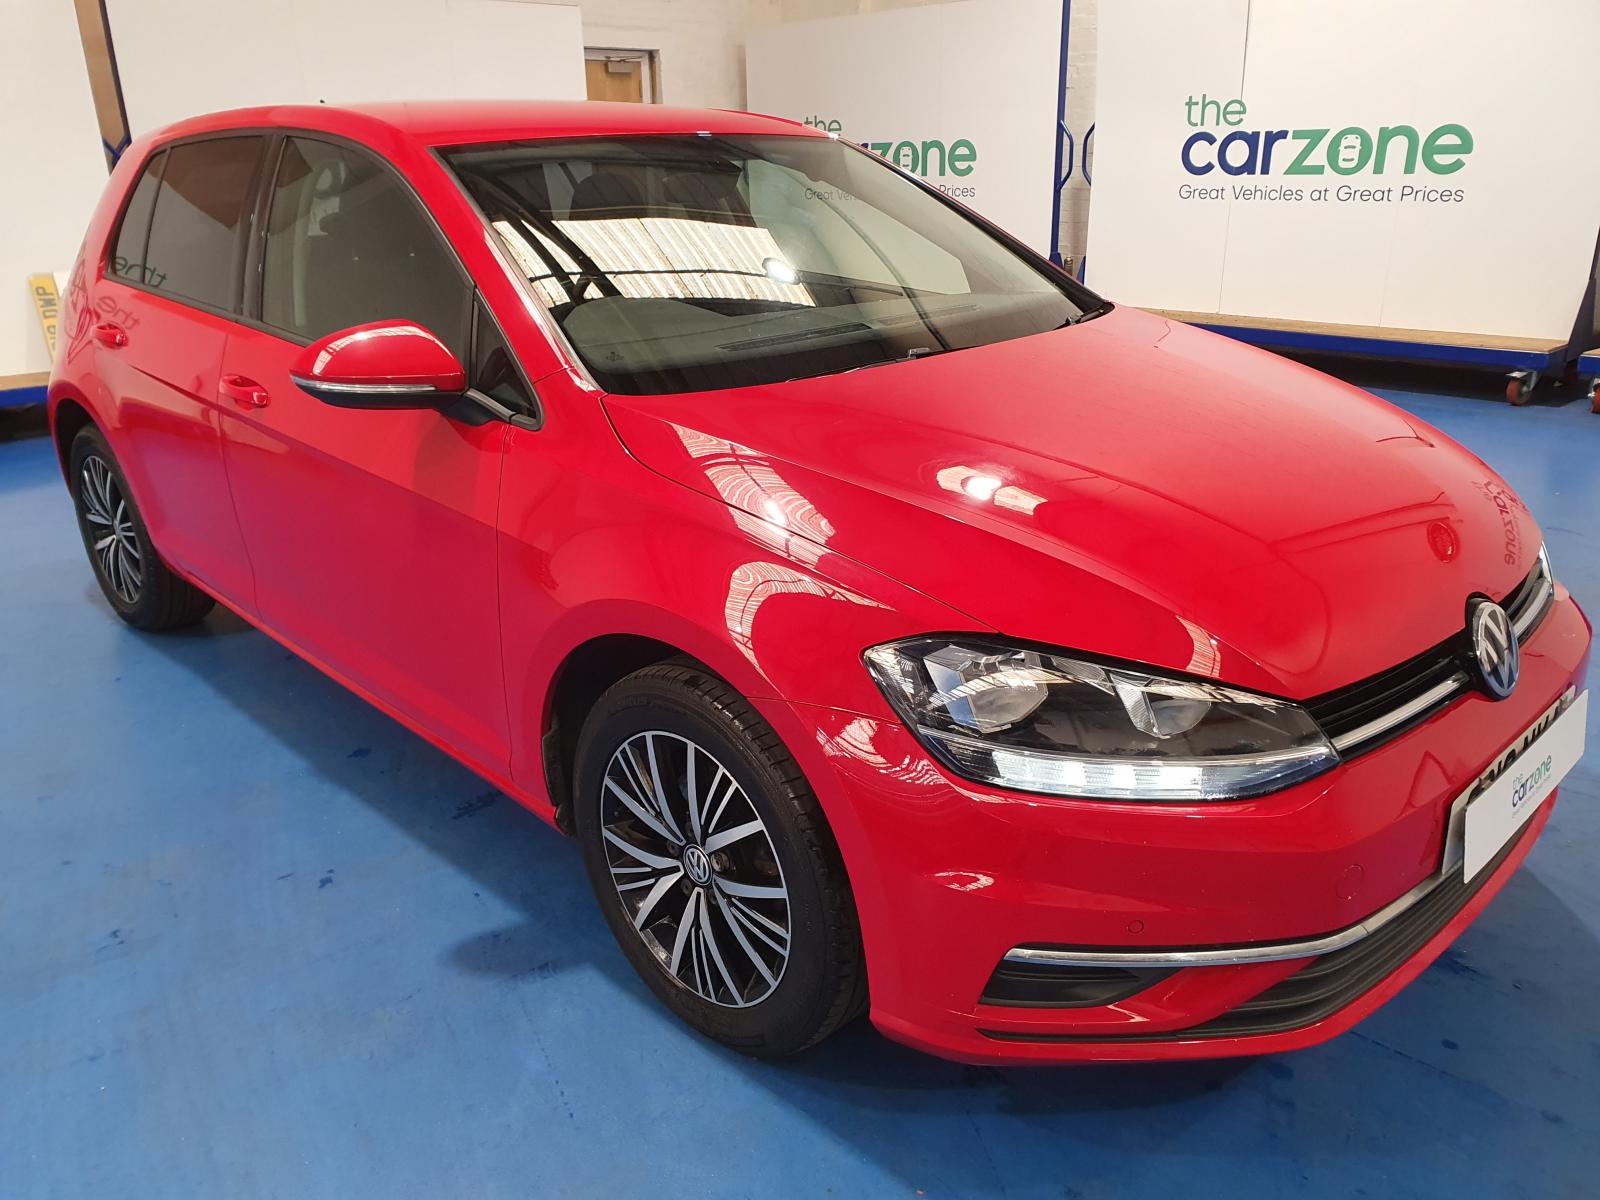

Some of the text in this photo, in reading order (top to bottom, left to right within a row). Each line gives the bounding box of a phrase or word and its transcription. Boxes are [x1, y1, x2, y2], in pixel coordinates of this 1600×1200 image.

[1185, 94, 1247, 127] the
[1181, 123, 1474, 176] carzone
[804, 187, 834, 200] Great
[1178, 184, 1465, 203] Great Vehicles at Great Prices
[1512, 755, 1552, 808] carzone
